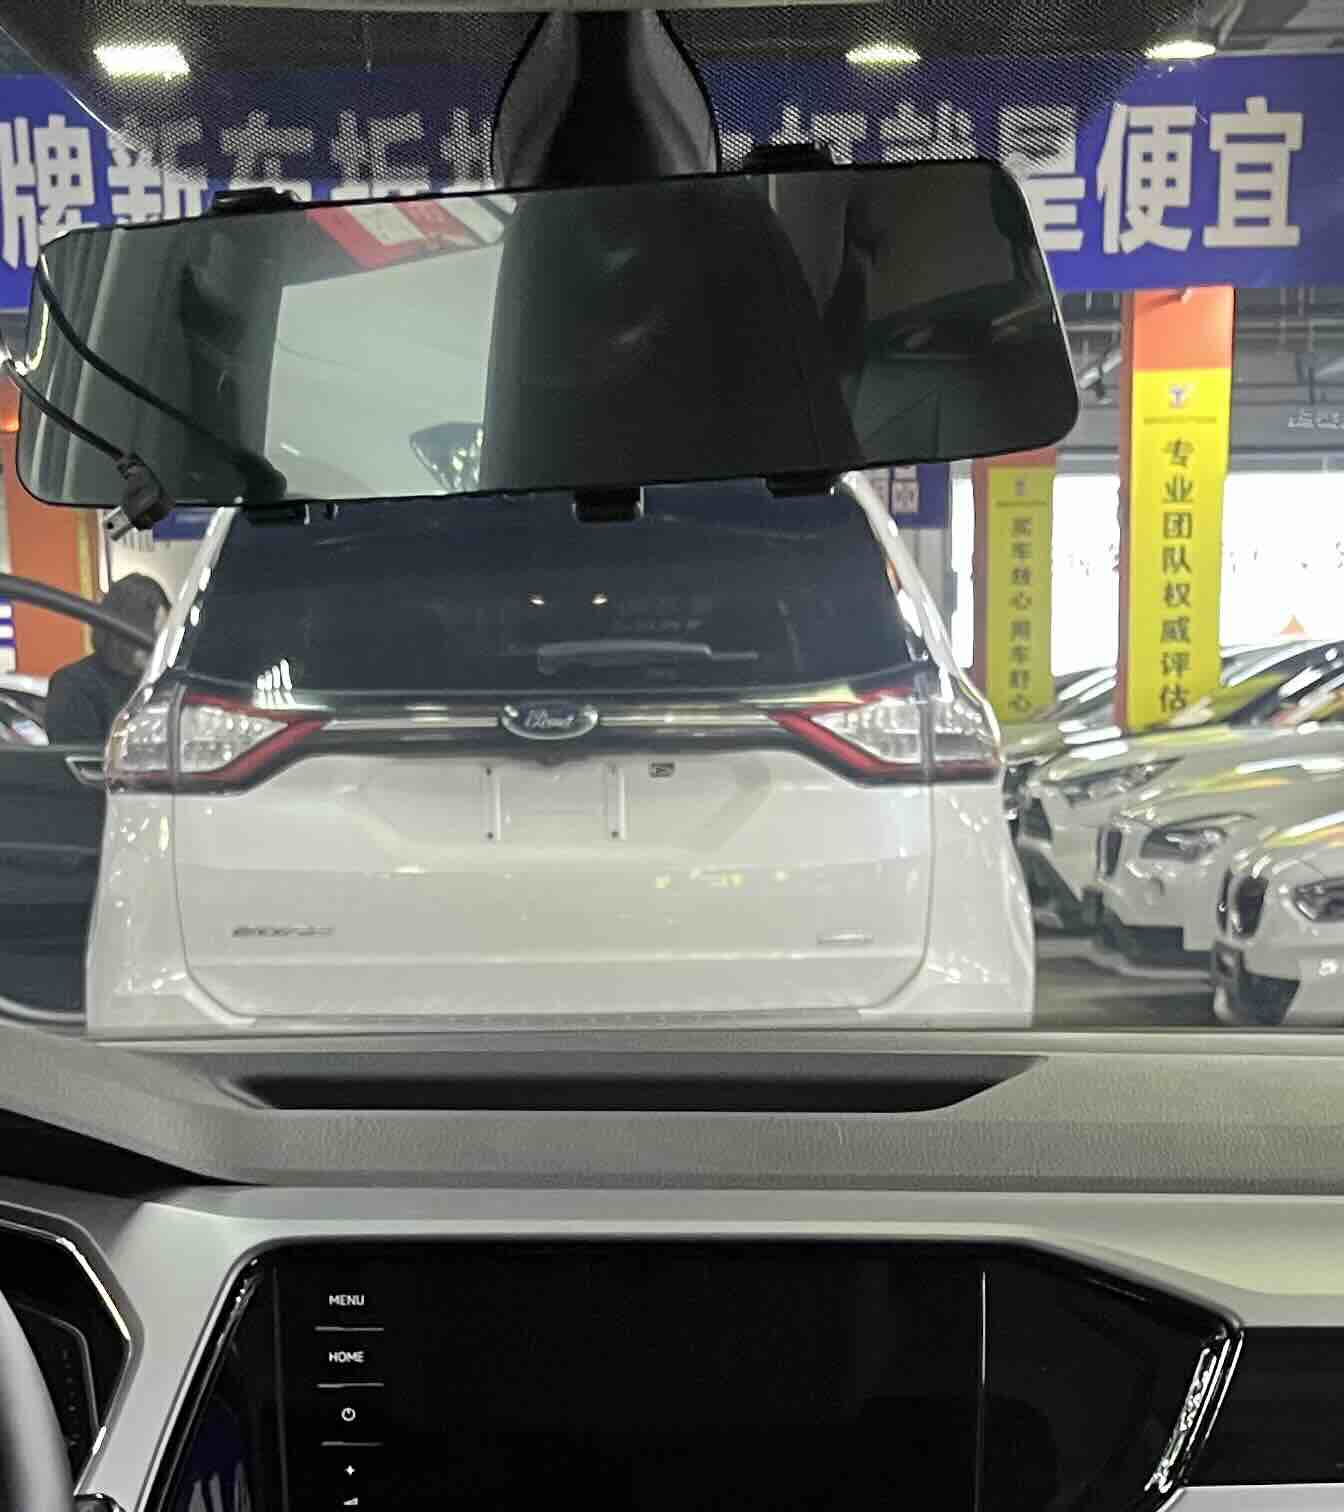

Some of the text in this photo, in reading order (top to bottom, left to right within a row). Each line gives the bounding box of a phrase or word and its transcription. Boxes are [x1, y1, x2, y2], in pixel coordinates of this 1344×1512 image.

[1158, 439, 1194, 713] 专业团队权威评估
[328, 1294, 365, 1306] MENU
[328, 1351, 365, 1363] HOME
